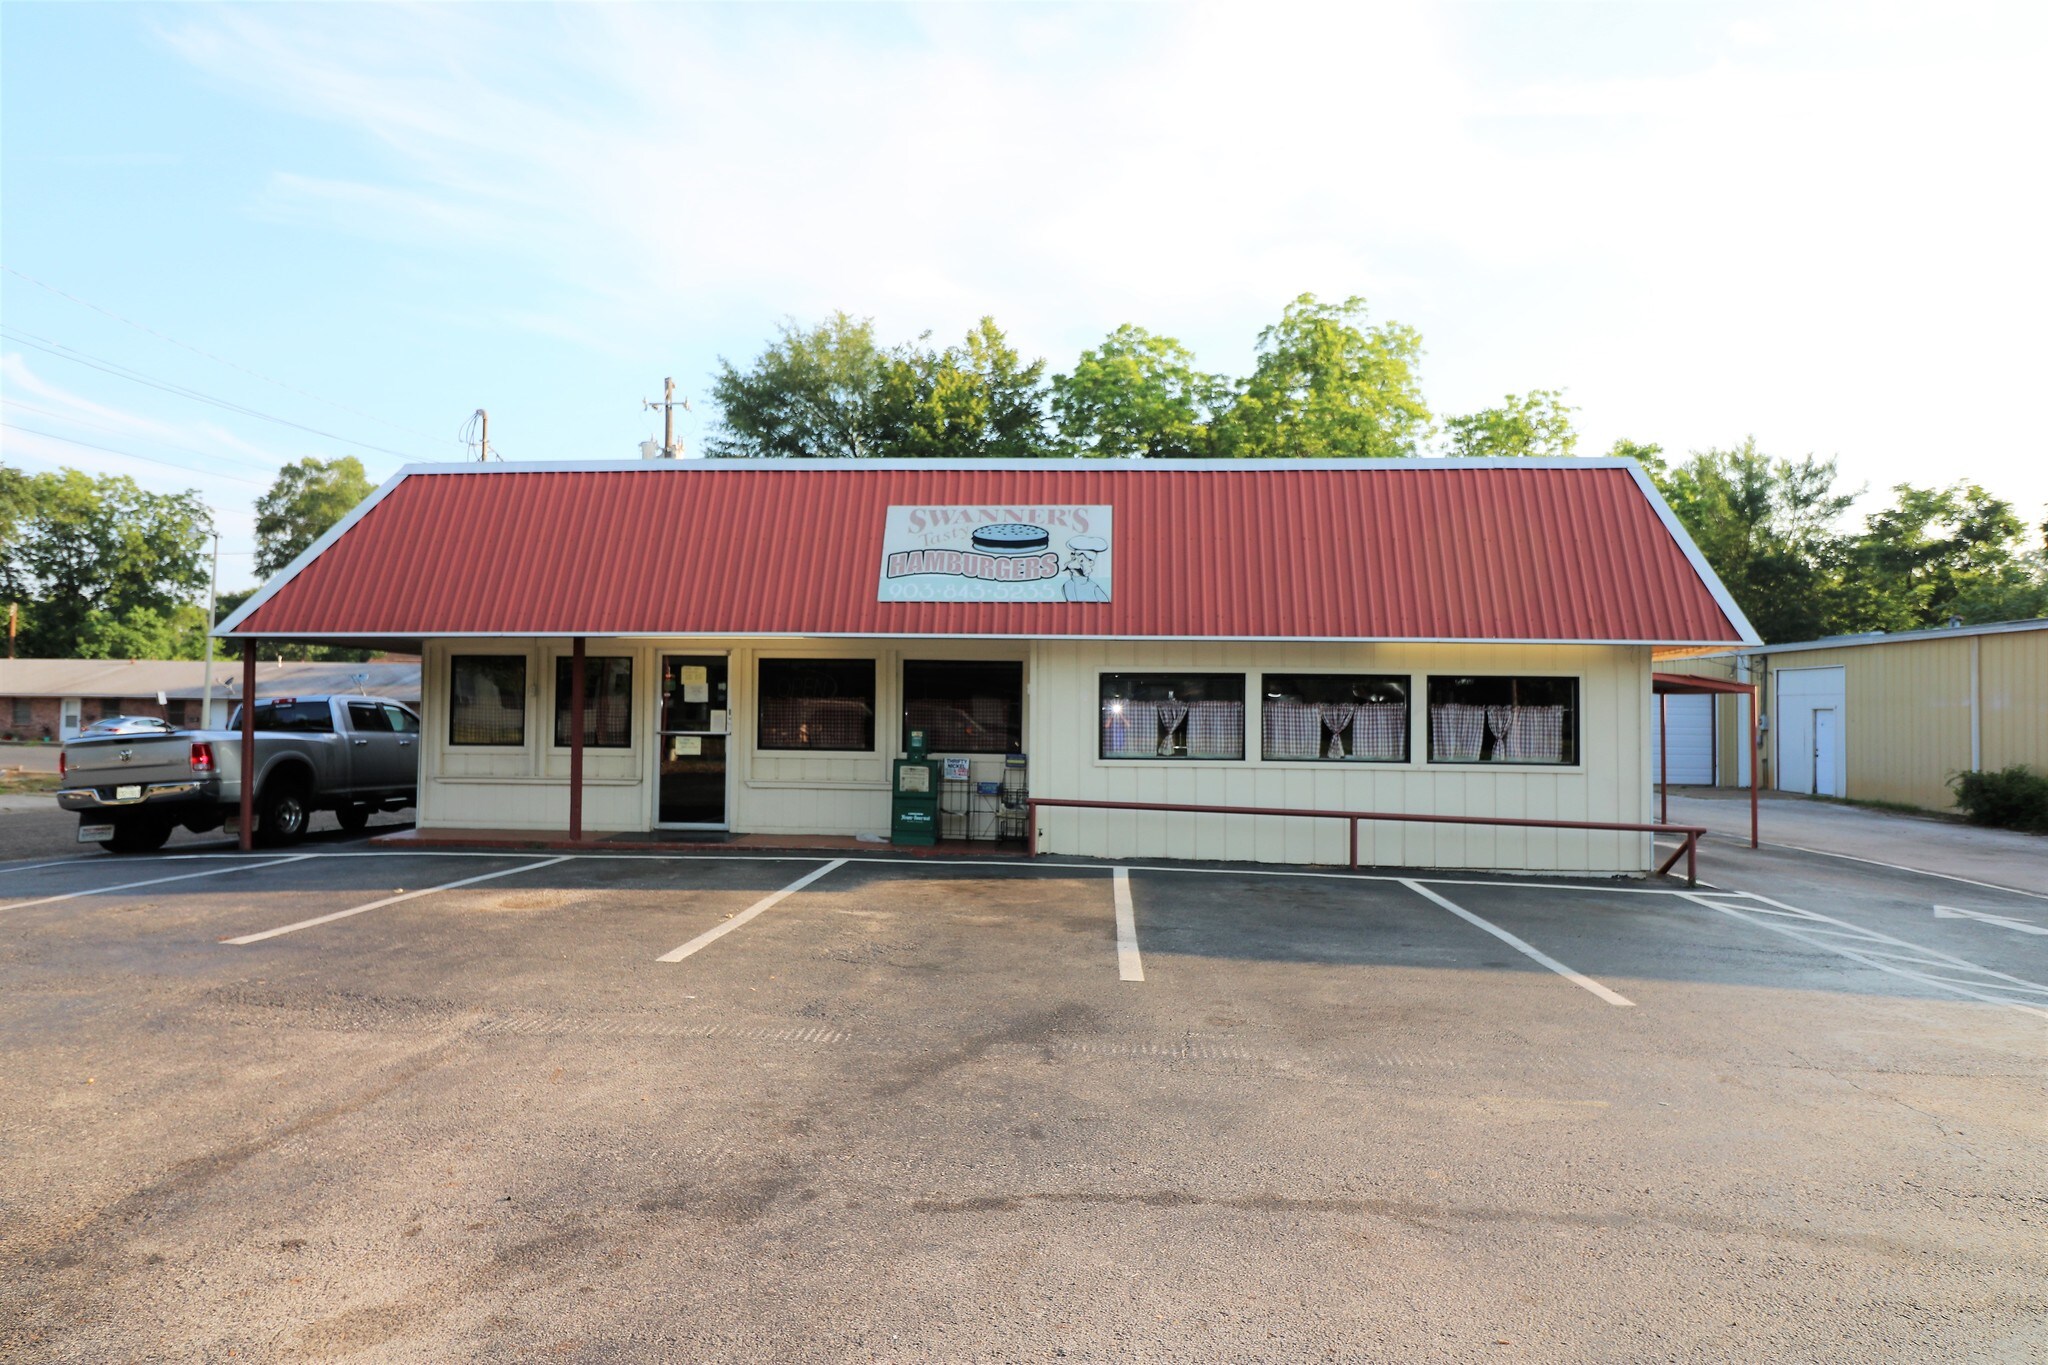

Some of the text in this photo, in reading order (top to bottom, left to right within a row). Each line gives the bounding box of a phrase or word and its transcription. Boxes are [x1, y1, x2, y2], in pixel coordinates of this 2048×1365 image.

[908, 507, 1089, 534] SWANNER'S
[918, 526, 970, 547] Tasty
[887, 548, 1059, 582] HAMBURGERS
